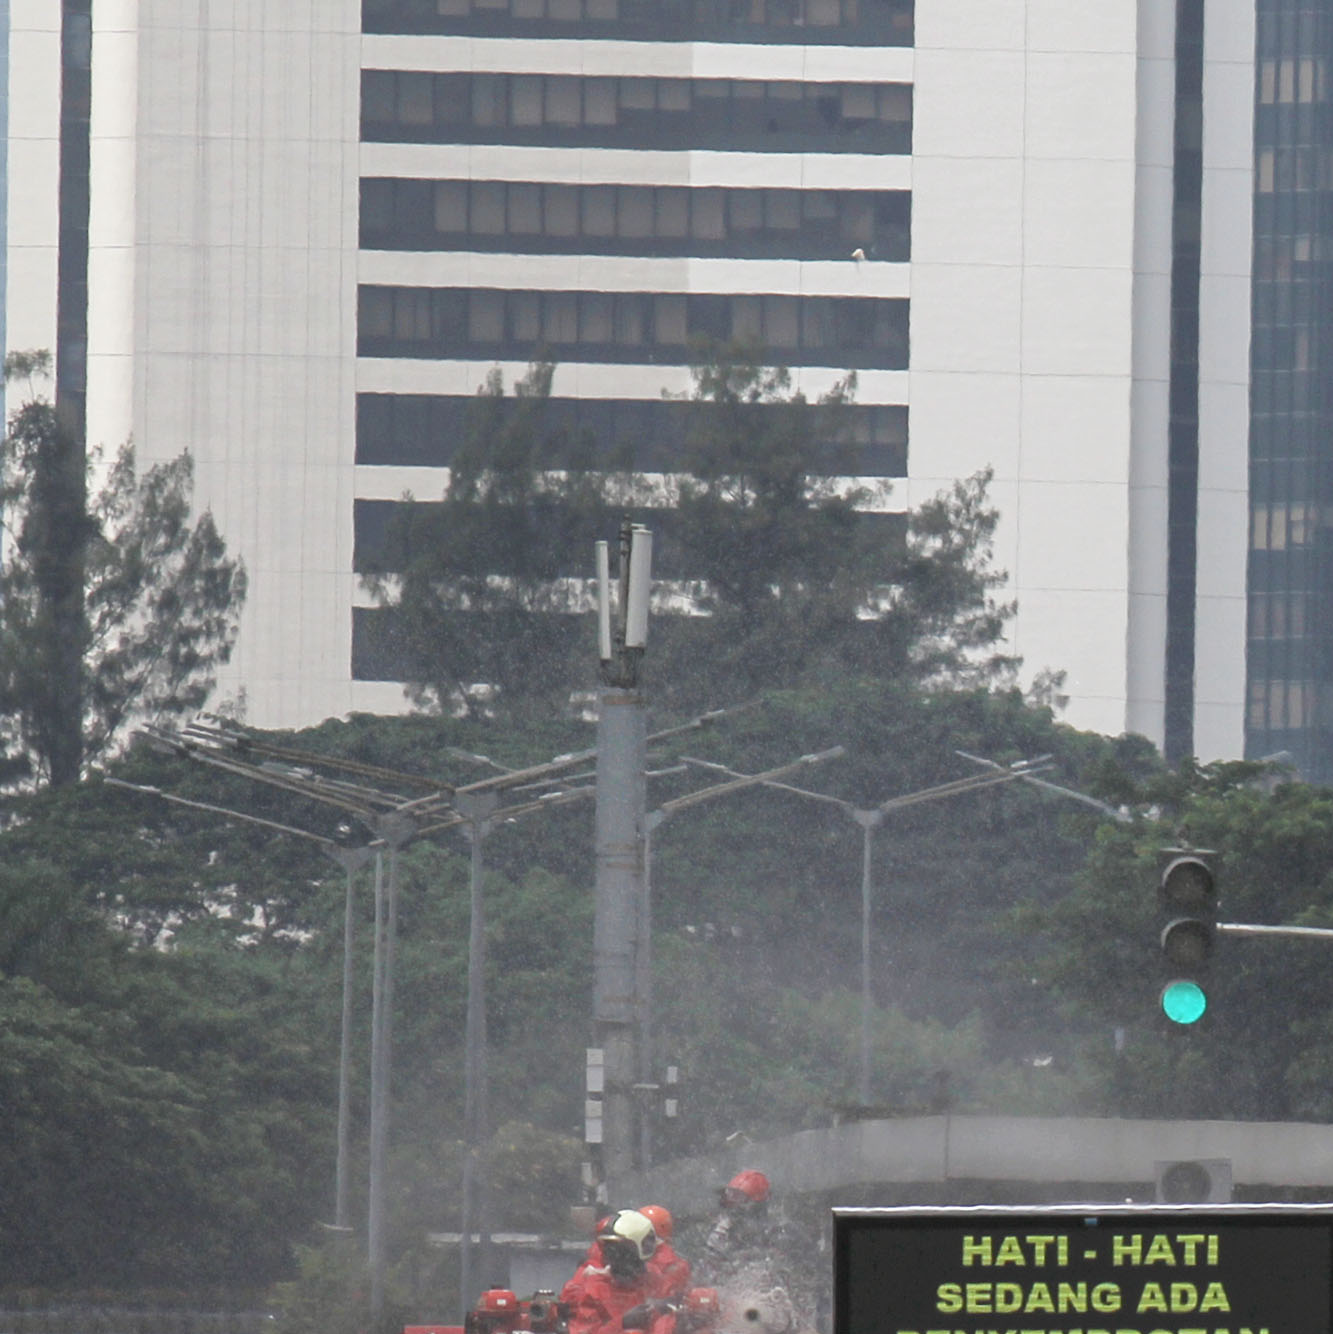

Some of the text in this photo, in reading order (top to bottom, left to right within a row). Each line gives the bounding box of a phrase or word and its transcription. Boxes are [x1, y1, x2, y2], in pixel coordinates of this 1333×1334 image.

[962, 1233, 1219, 1267] HATI - HATI
[936, 1281, 1231, 1314] SEDANG ADA
